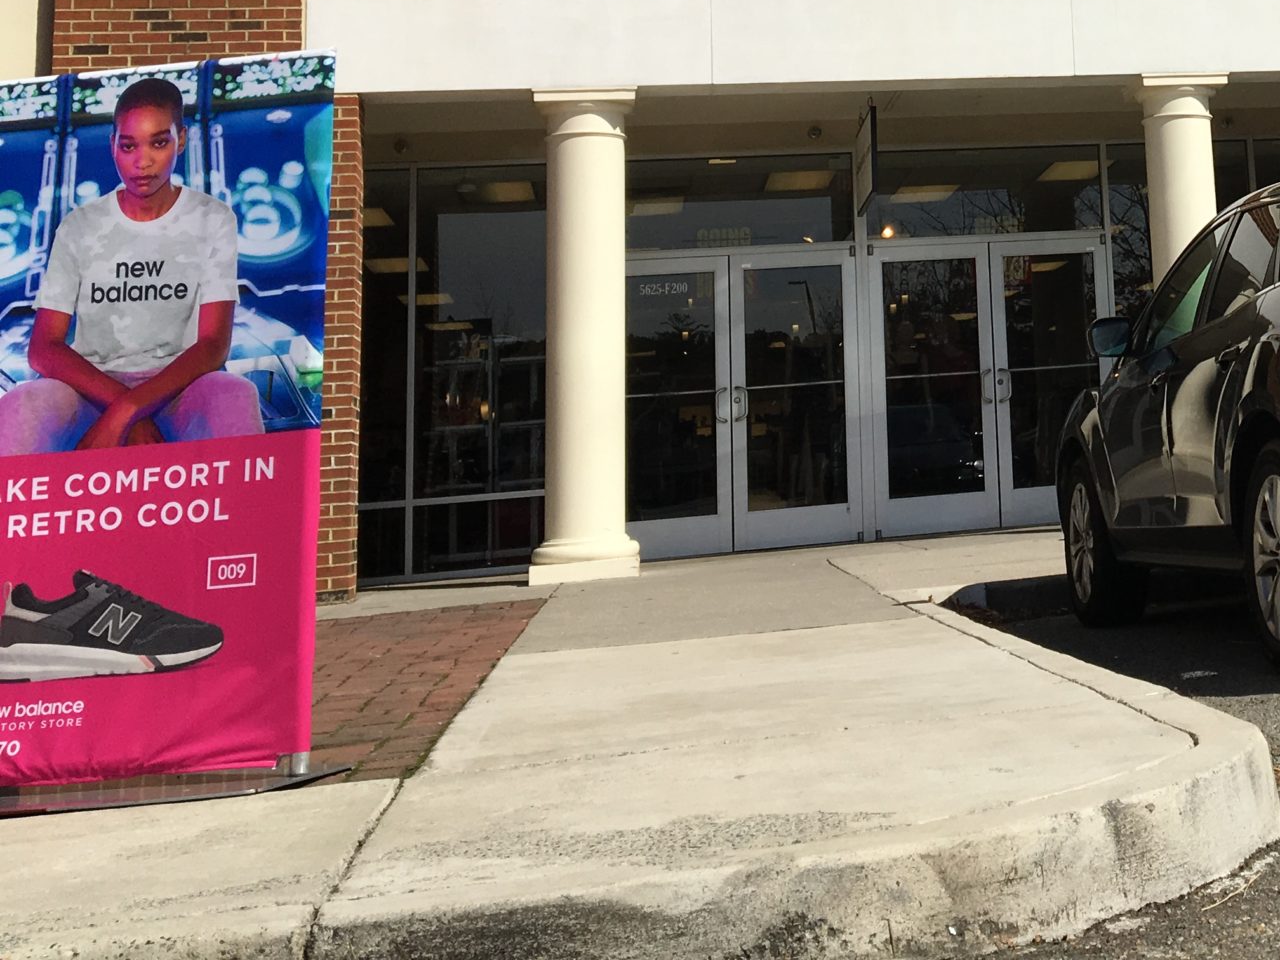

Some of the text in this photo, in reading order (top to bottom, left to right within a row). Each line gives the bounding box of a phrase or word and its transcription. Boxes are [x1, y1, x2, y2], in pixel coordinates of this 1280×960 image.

[115, 260, 165, 278] new
[90, 280, 188, 304] balance
[0, 456, 275, 503] KE COMFORT IN
[7, 498, 229, 538] RETRO COOL
[217, 563, 247, 580] 009
[14, 700, 85, 718] balance
[40, 717, 83, 729] STORE
